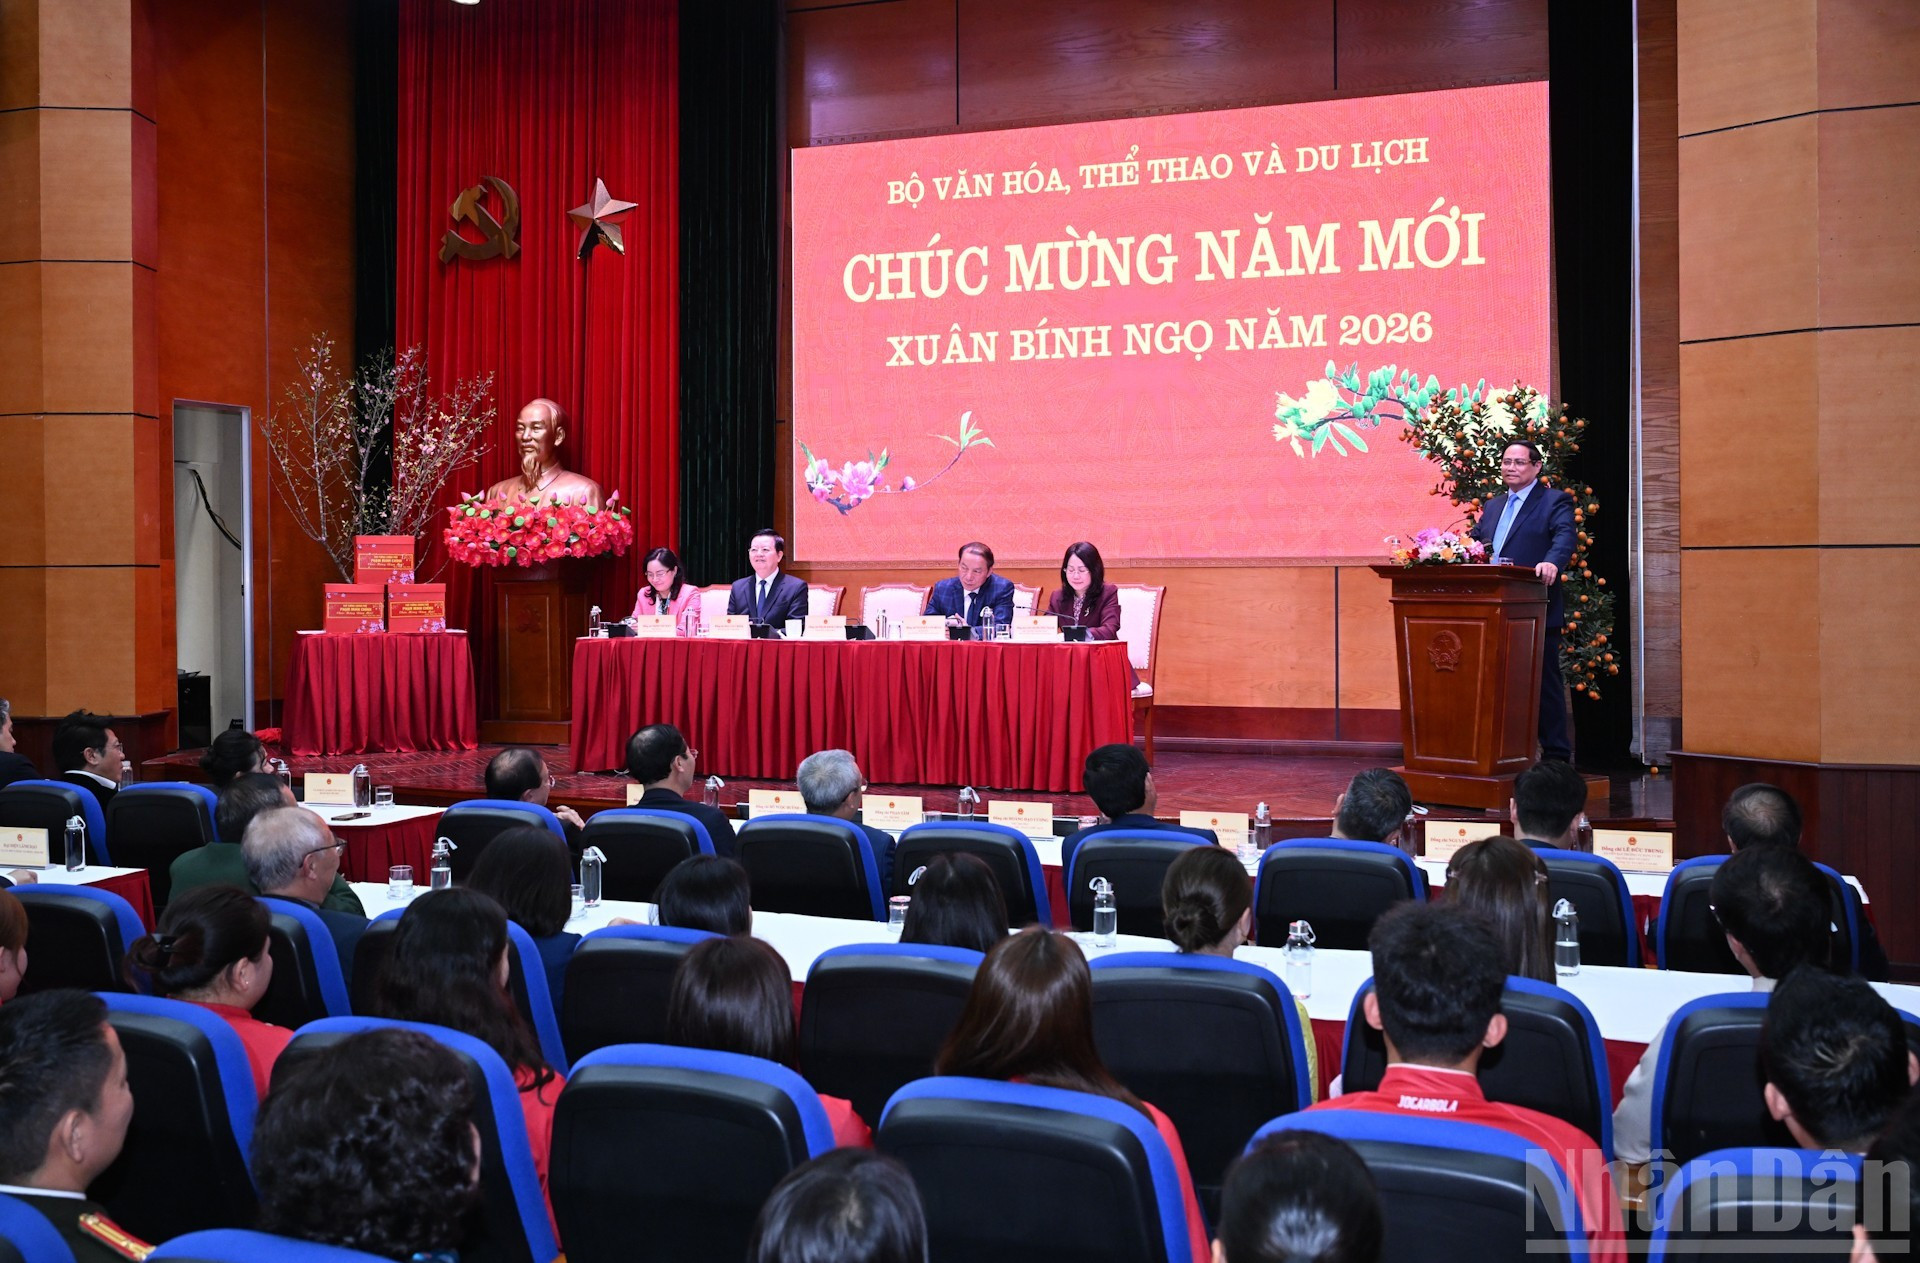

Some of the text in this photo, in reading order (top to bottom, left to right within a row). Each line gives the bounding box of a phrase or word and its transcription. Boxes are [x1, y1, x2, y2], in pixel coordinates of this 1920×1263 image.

[888, 138, 1430, 208] BỘ VĂN HÓA, THỂ THAO VÀ DU LỊCH
[843, 197, 1486, 302] CHÚC MỪNG NĂM MỚI
[886, 306, 1433, 367] XUÂN BÍNH NGỌ NĂM 2026
